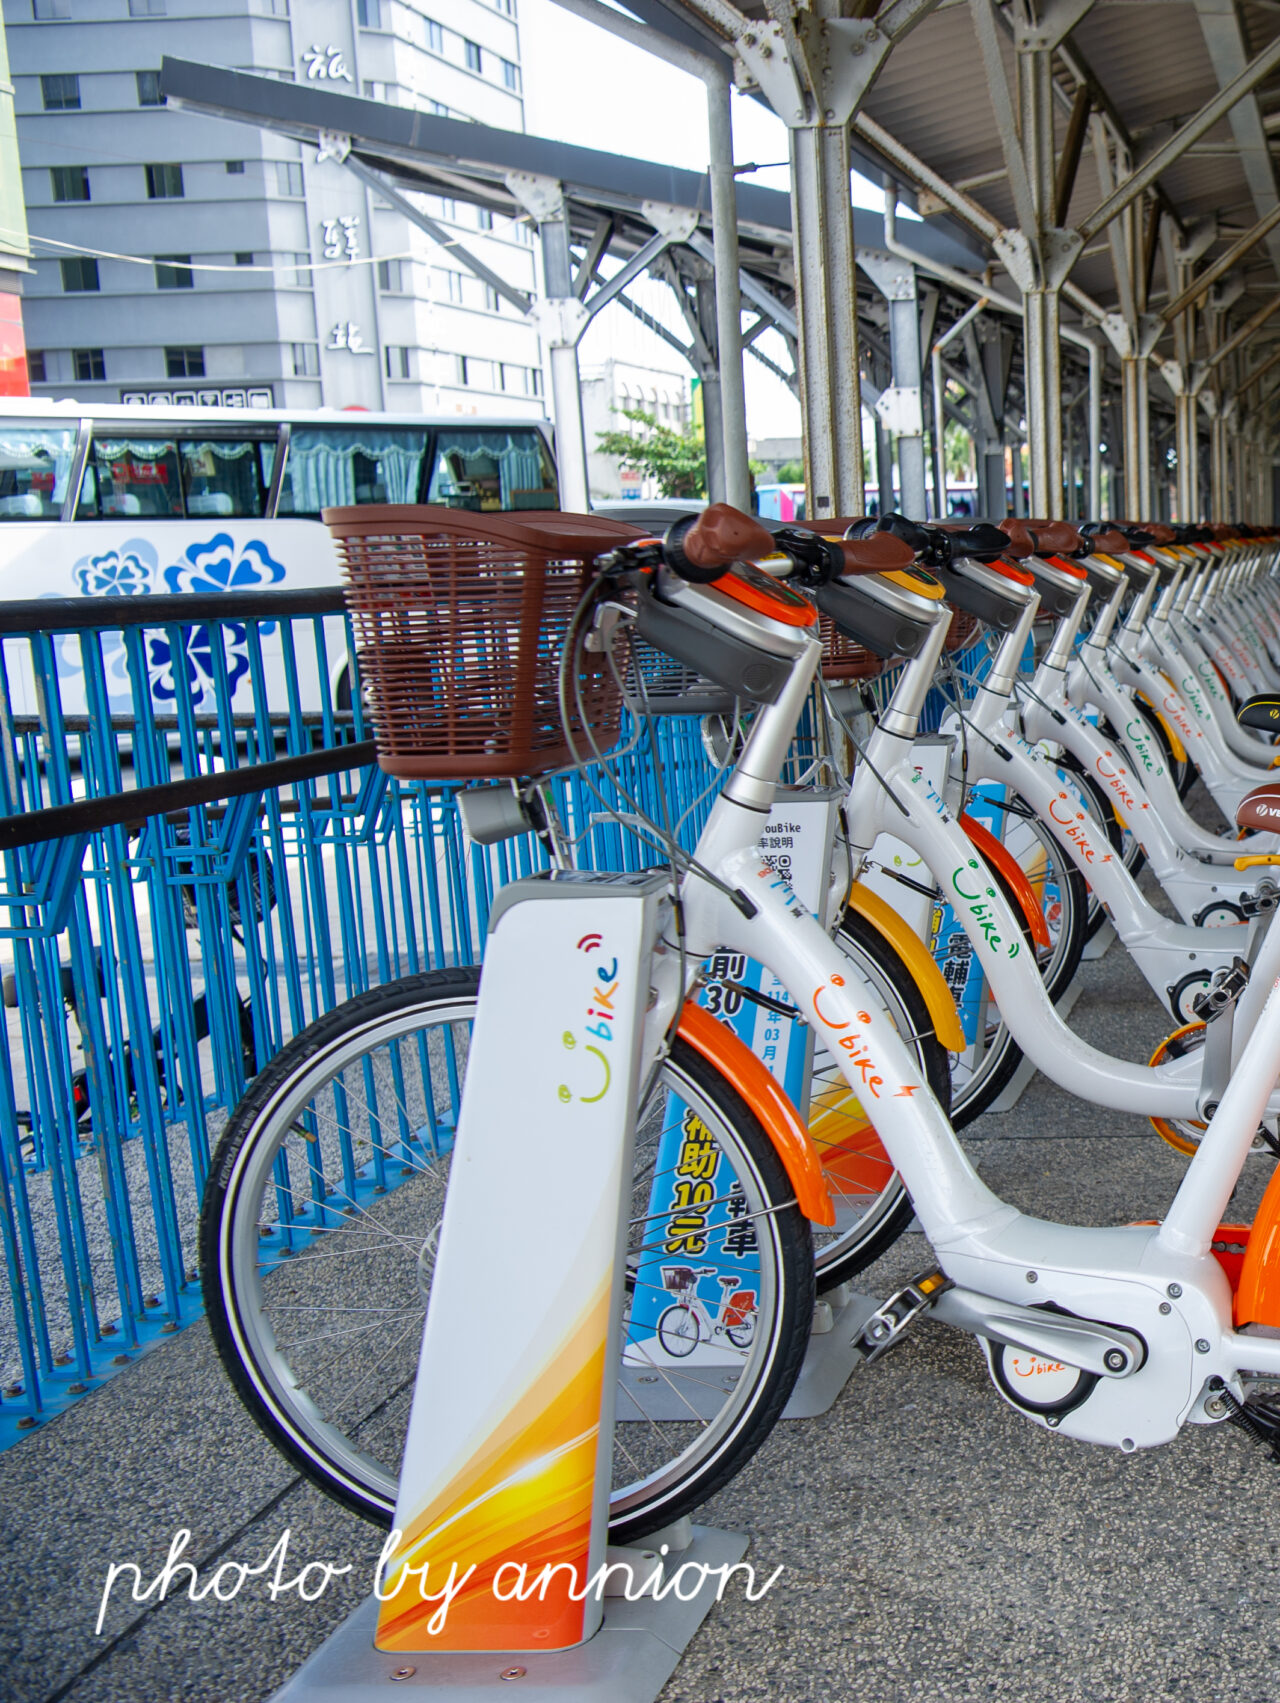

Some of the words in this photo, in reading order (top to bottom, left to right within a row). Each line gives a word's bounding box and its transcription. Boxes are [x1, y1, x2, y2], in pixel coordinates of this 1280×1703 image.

[303, 45, 375, 355] 旅驛站
[764, 822, 801, 834] ouBike
